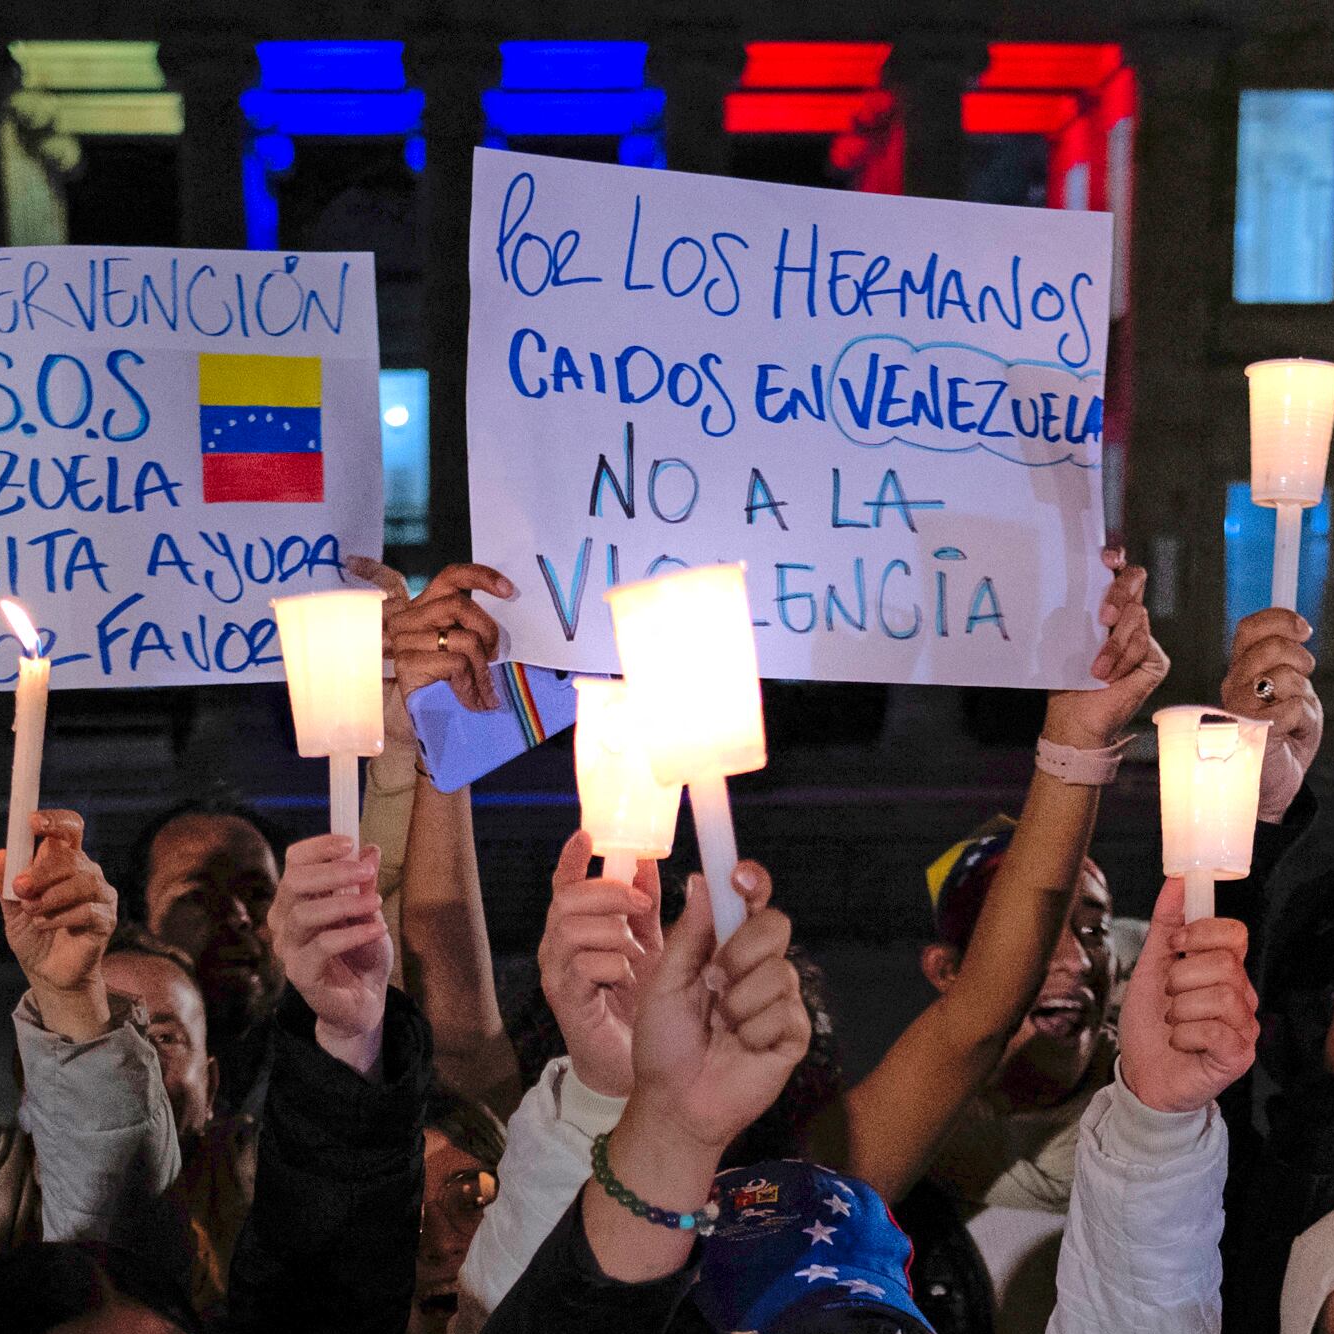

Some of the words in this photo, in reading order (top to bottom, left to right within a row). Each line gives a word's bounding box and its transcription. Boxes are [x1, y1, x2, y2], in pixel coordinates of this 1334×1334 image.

[495, 172, 603, 297] POR
[624, 195, 749, 317] LOS
[772, 223, 1094, 368] HERMANOS
[507, 328, 736, 437] CAIDOS
[754, 363, 826, 424] EN
[838, 352, 1104, 445] VENEZUELA
[588, 421, 701, 525] NO
[745, 467, 789, 532] A
[831, 467, 945, 534] LA
[147, 531, 346, 604] AYUDA
